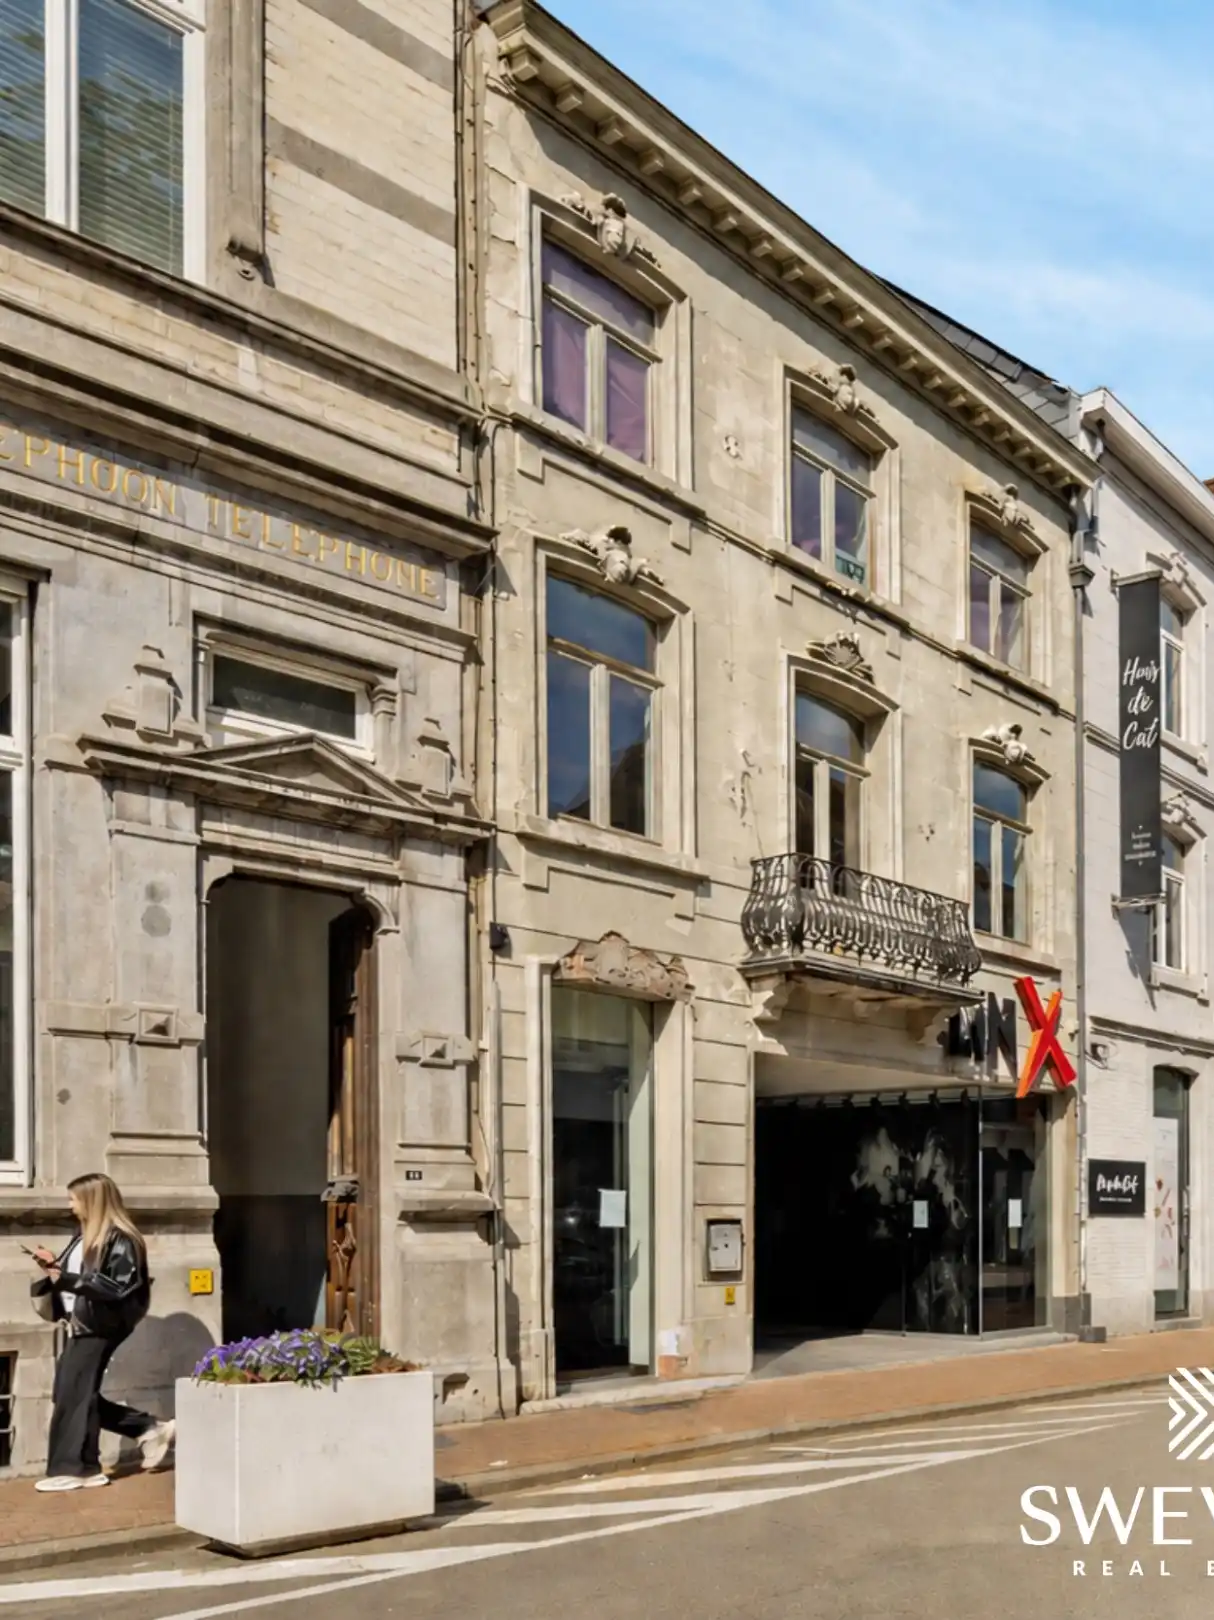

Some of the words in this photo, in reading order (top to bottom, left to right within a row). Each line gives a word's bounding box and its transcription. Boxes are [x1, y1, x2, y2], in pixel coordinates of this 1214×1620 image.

[205, 492, 440, 600] TELEPHONE
[1127, 686, 1154, 715] de
[1123, 717, 1158, 750] Cat
